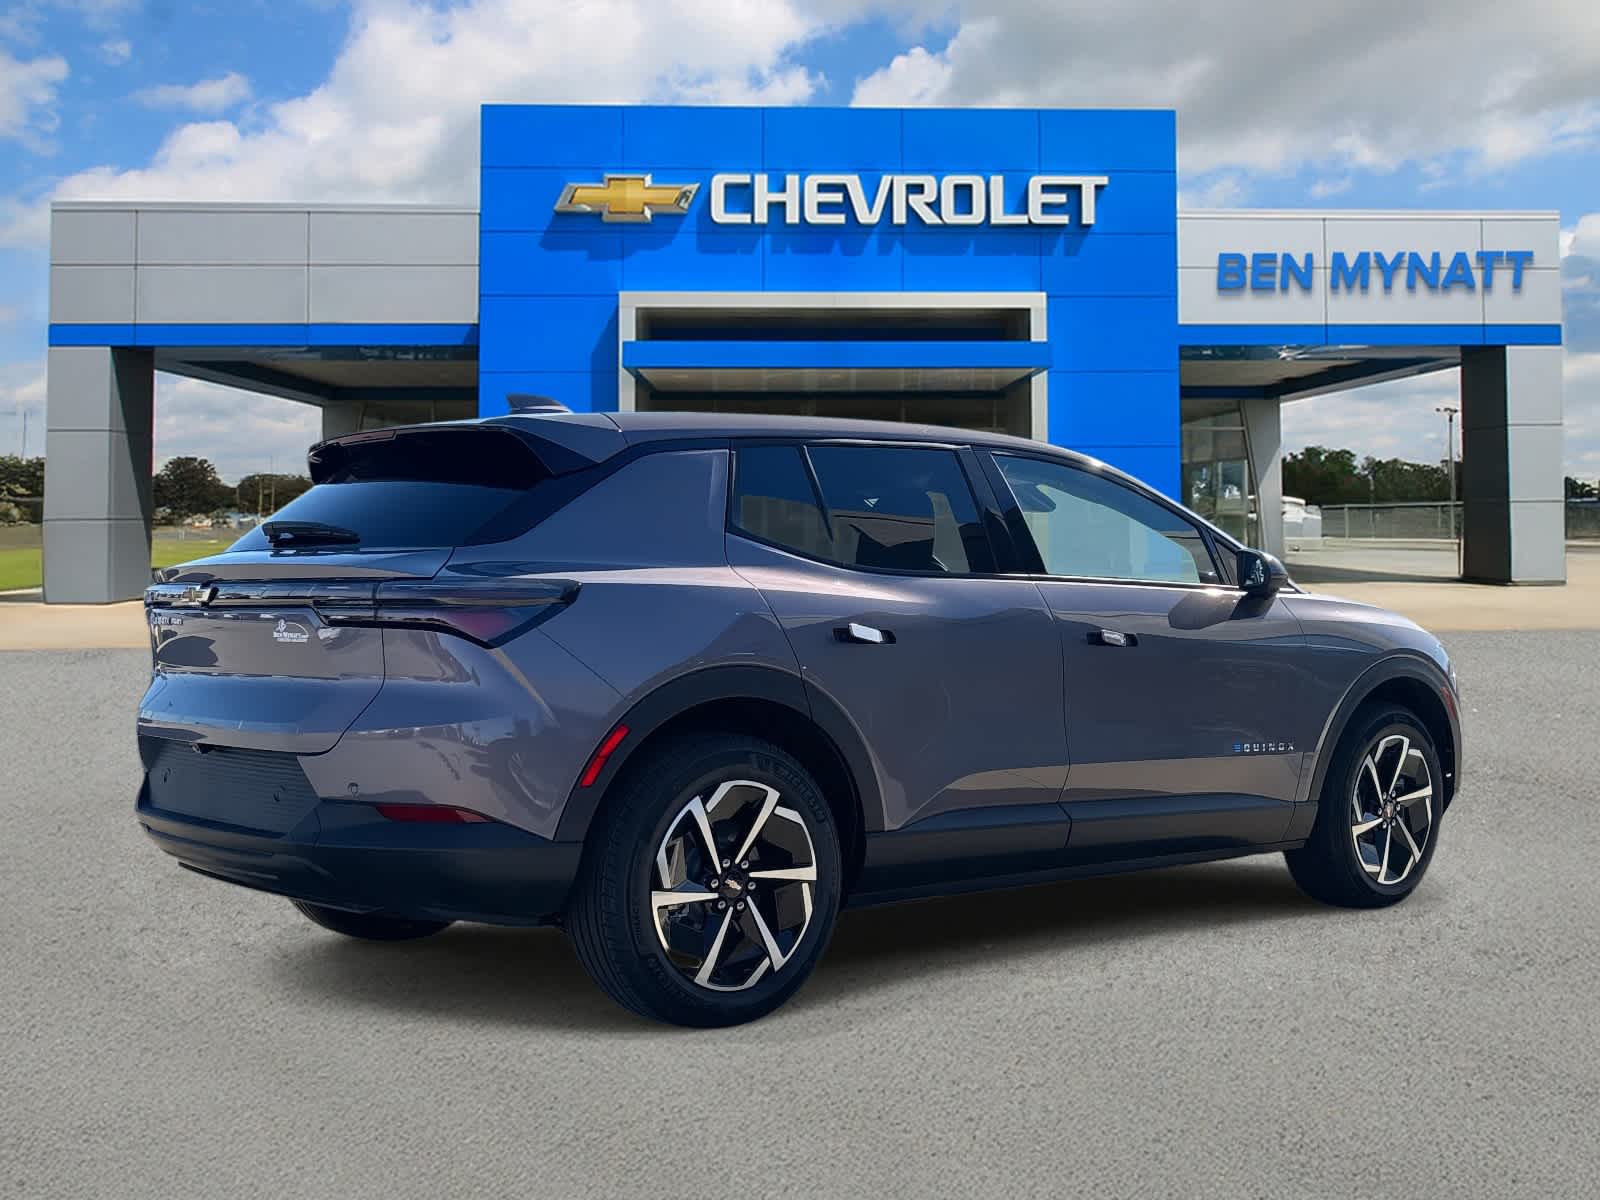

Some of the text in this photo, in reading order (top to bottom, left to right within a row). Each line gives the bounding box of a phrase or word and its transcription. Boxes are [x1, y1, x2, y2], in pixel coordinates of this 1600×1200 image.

[710, 173, 1110, 226] CHEVROLET
[1217, 250, 1534, 290] BEN MYNATT
[1232, 742, 1295, 752] EQUINOX
